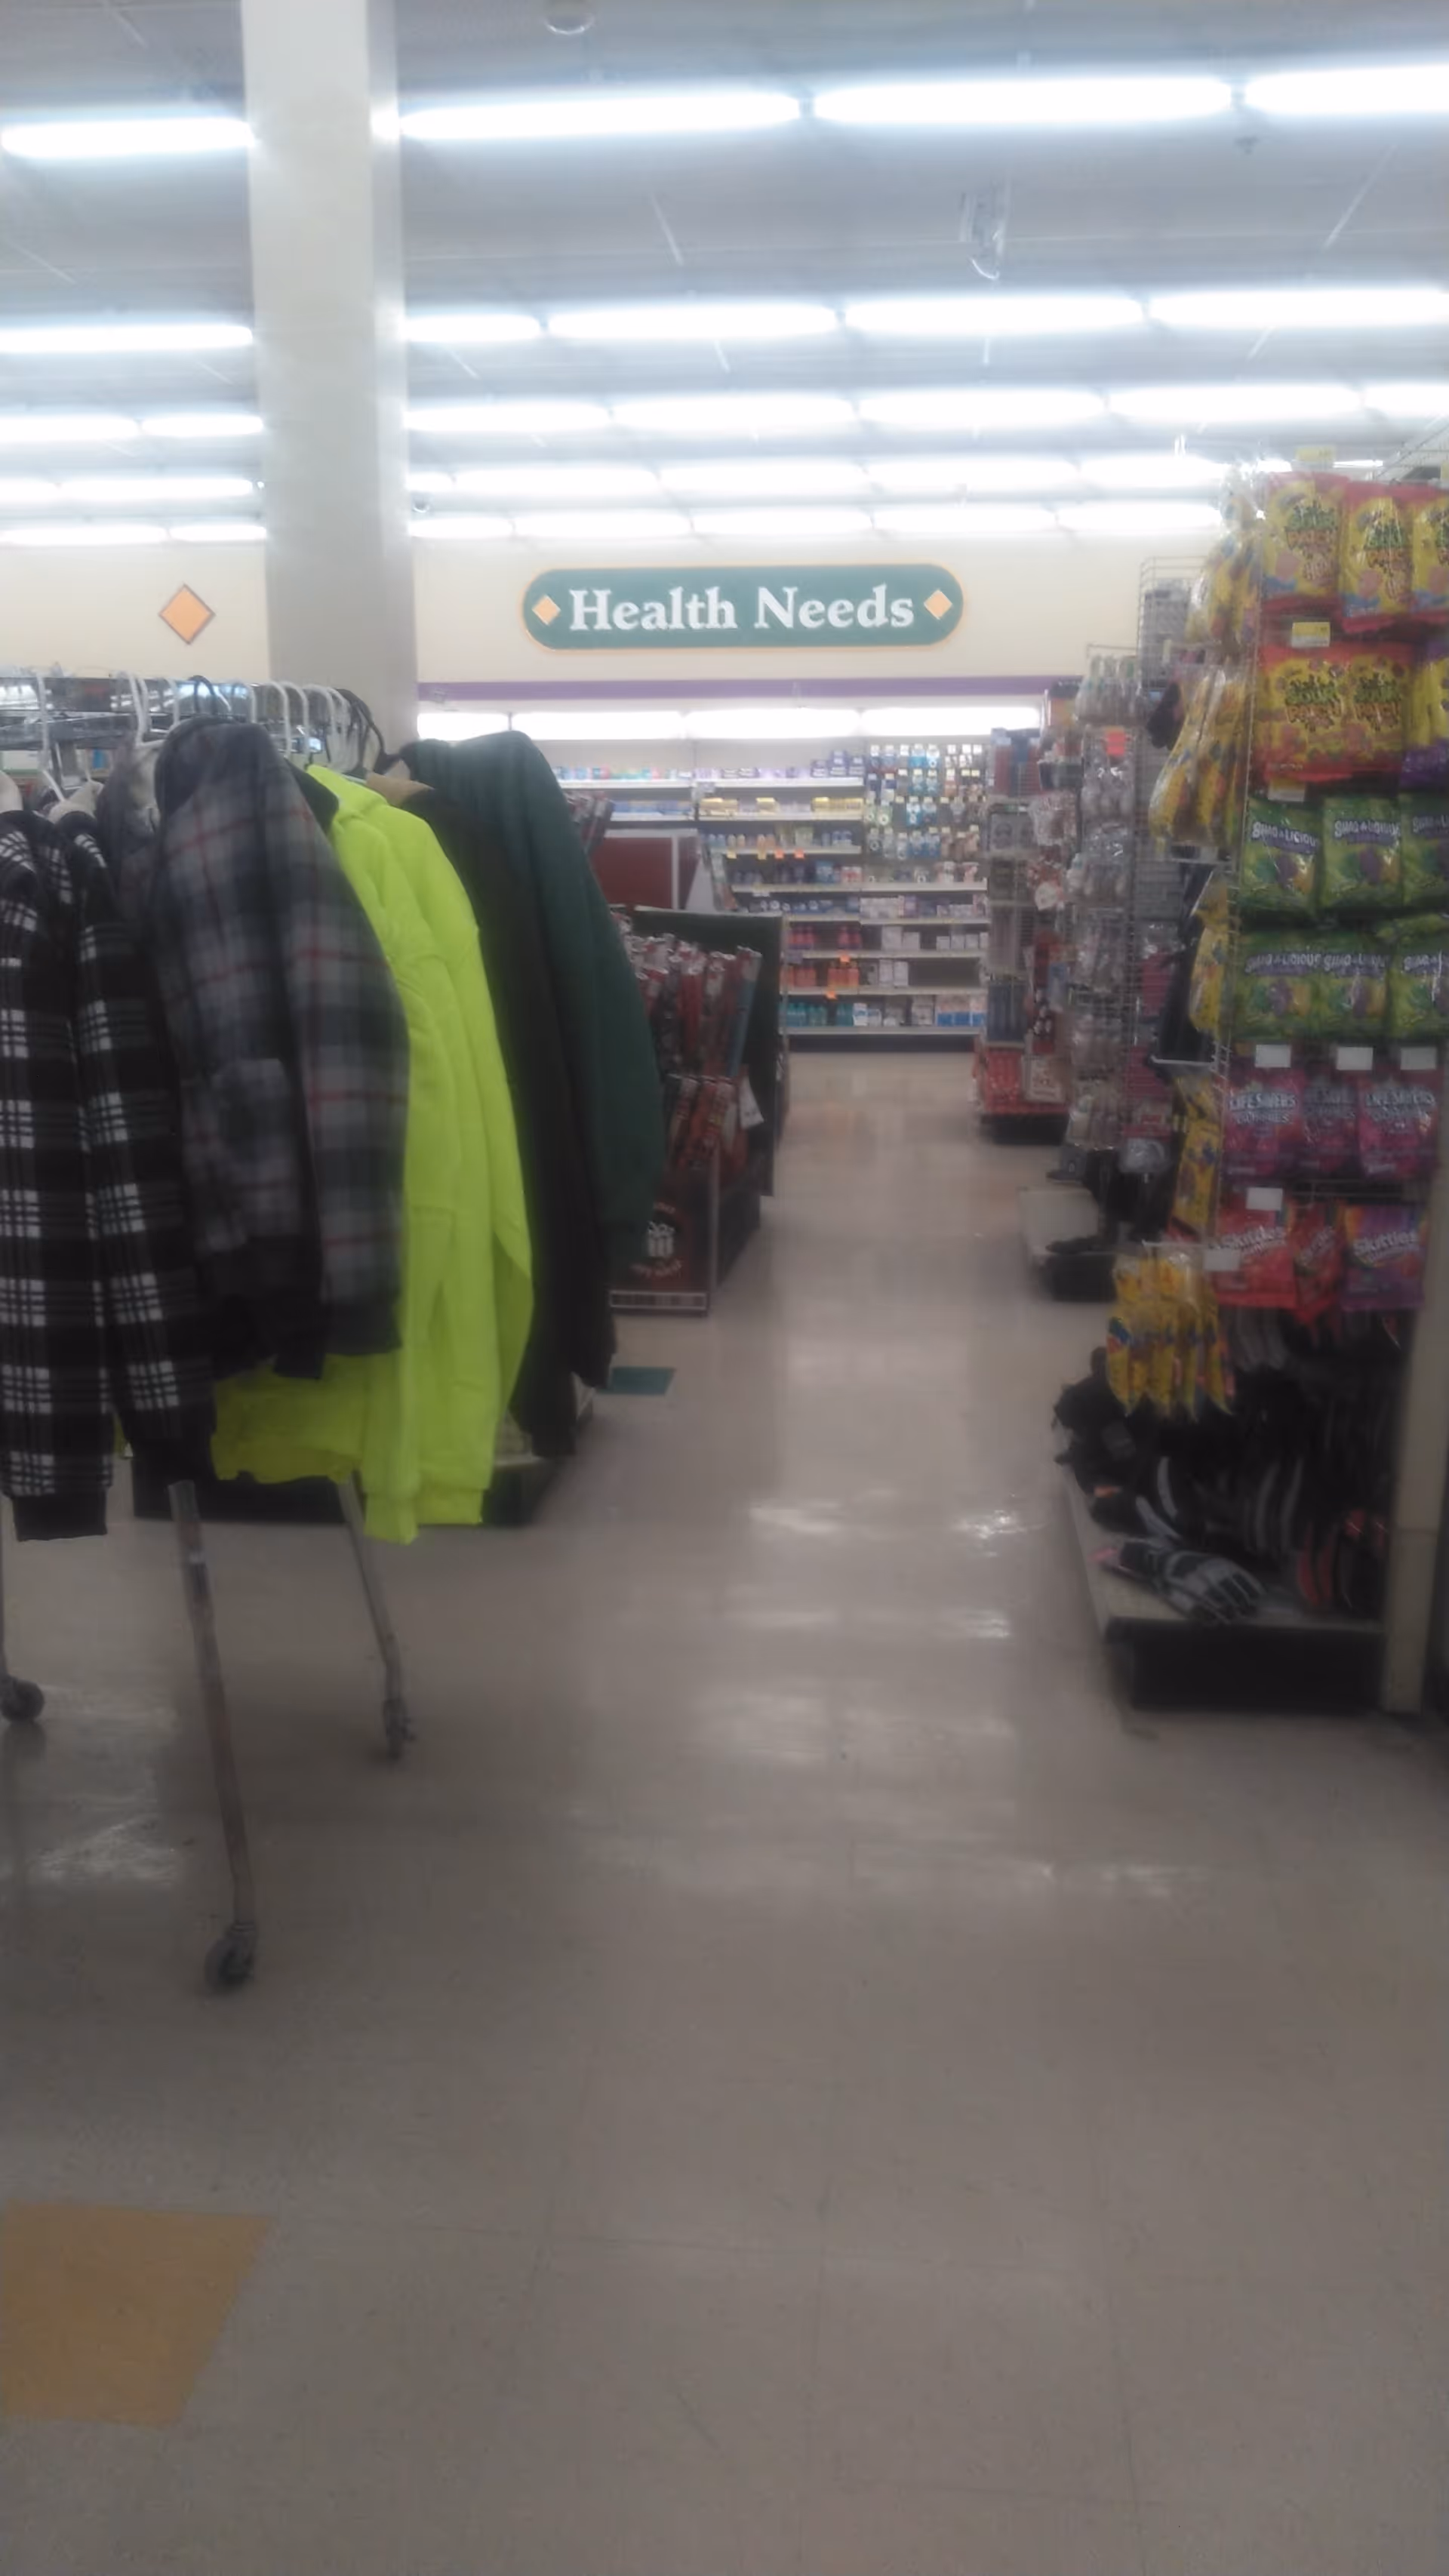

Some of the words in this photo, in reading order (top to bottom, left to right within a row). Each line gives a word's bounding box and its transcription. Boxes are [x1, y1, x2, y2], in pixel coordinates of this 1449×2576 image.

[569, 586, 738, 632] Health
[754, 583, 915, 629] Needs
[1285, 679, 1337, 705] SOUR
[1286, 703, 1343, 723] PATCH
[1221, 1226, 1287, 1250] Skittles
[1354, 1229, 1419, 1256] Skittles
